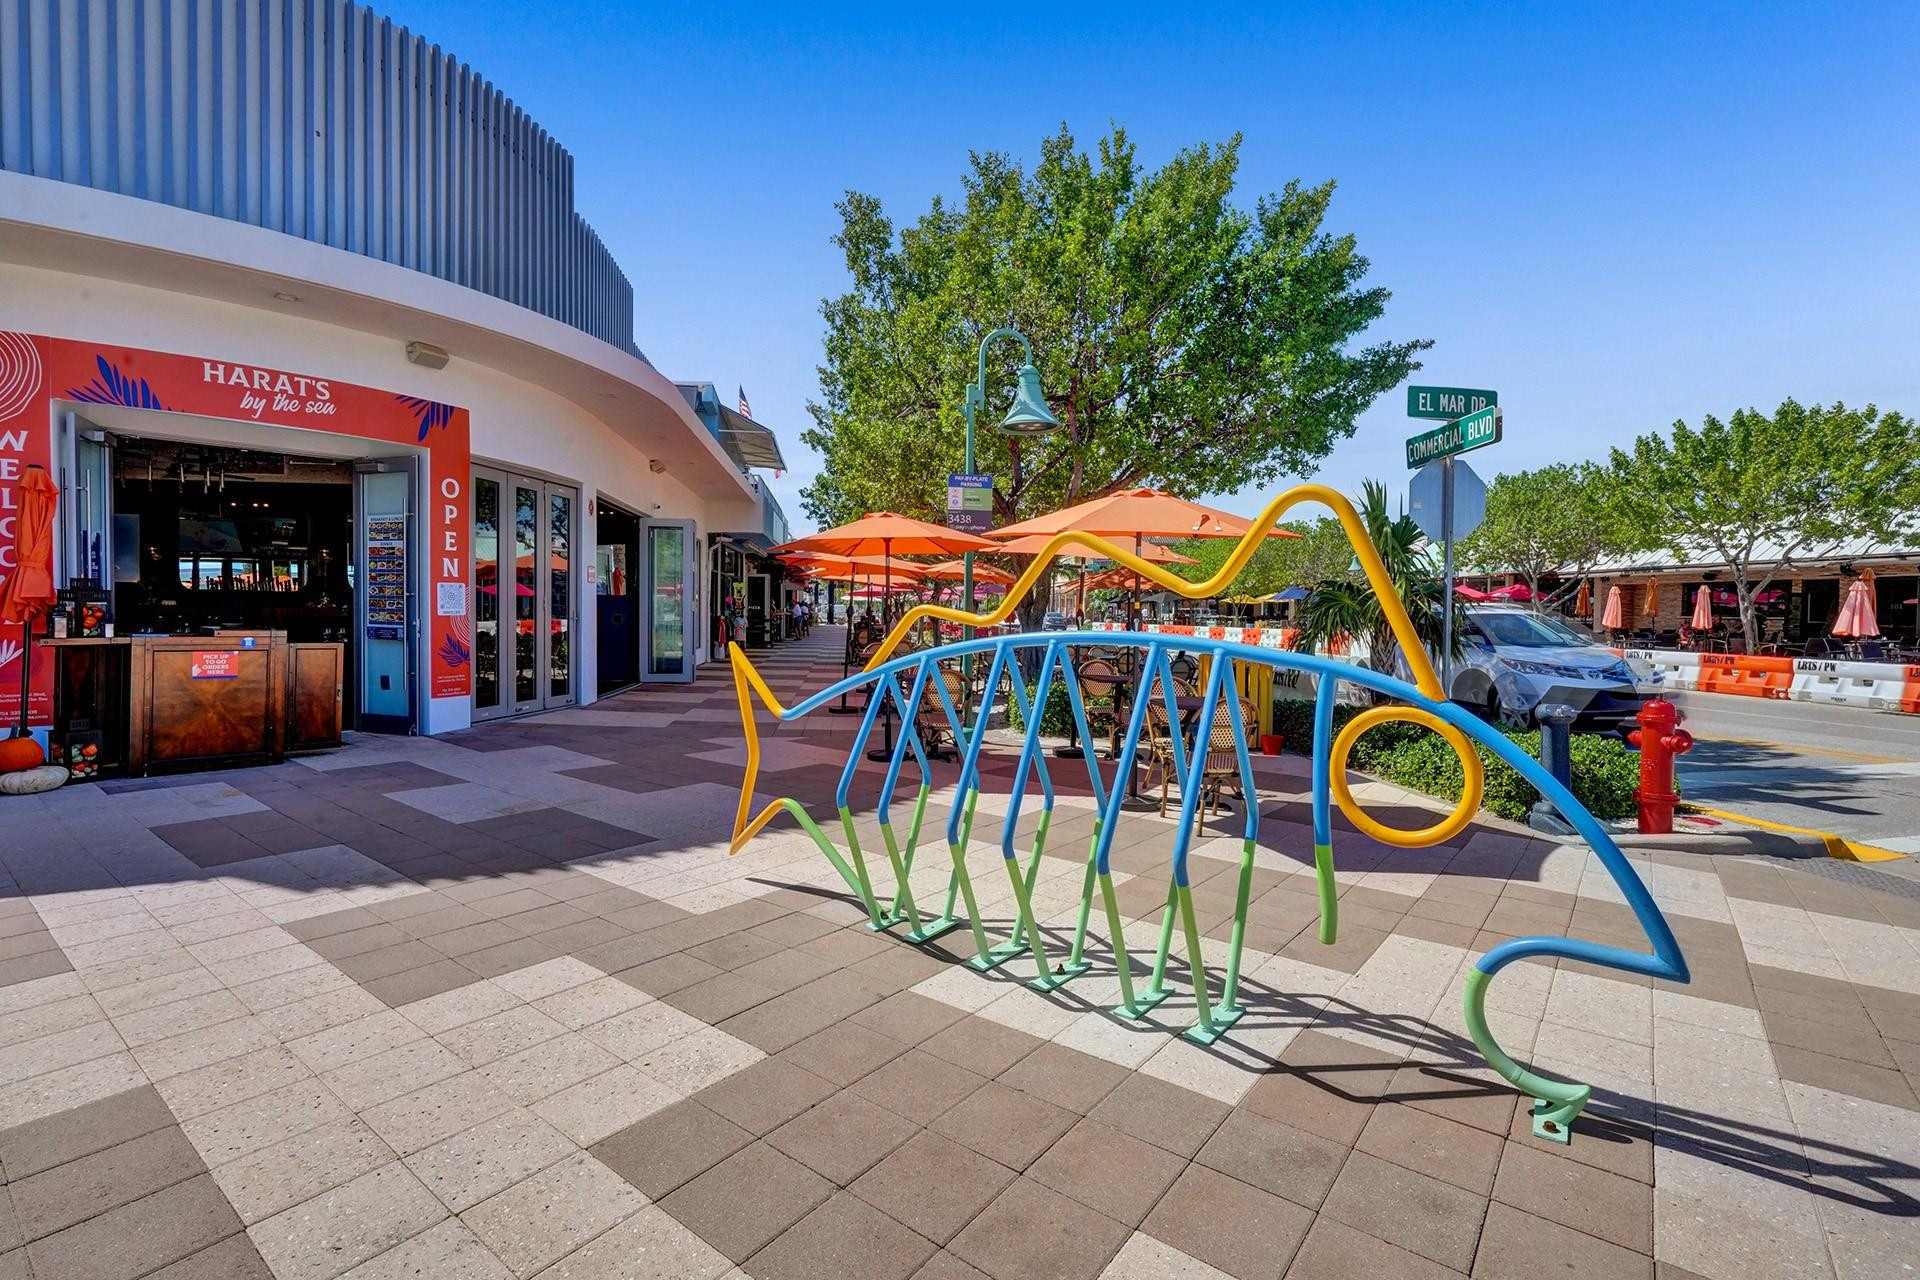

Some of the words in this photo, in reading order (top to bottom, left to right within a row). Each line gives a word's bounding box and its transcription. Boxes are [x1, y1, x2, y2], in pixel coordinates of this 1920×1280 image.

[203, 362, 330, 400] HARAT'S
[240, 391, 267, 419] by
[272, 393, 301, 412] the
[305, 400, 337, 415] sea
[1419, 393, 1434, 411] EL
[1440, 394, 1465, 413] MAR
[1407, 427, 1464, 463] COMMERCIAL
[1468, 415, 1493, 441] BLVD
[441, 477, 460, 578] OPEN
[948, 514, 972, 524] 3438
[1797, 660, 1818, 671] LBTS
[1823, 662, 1838, 672] PW
